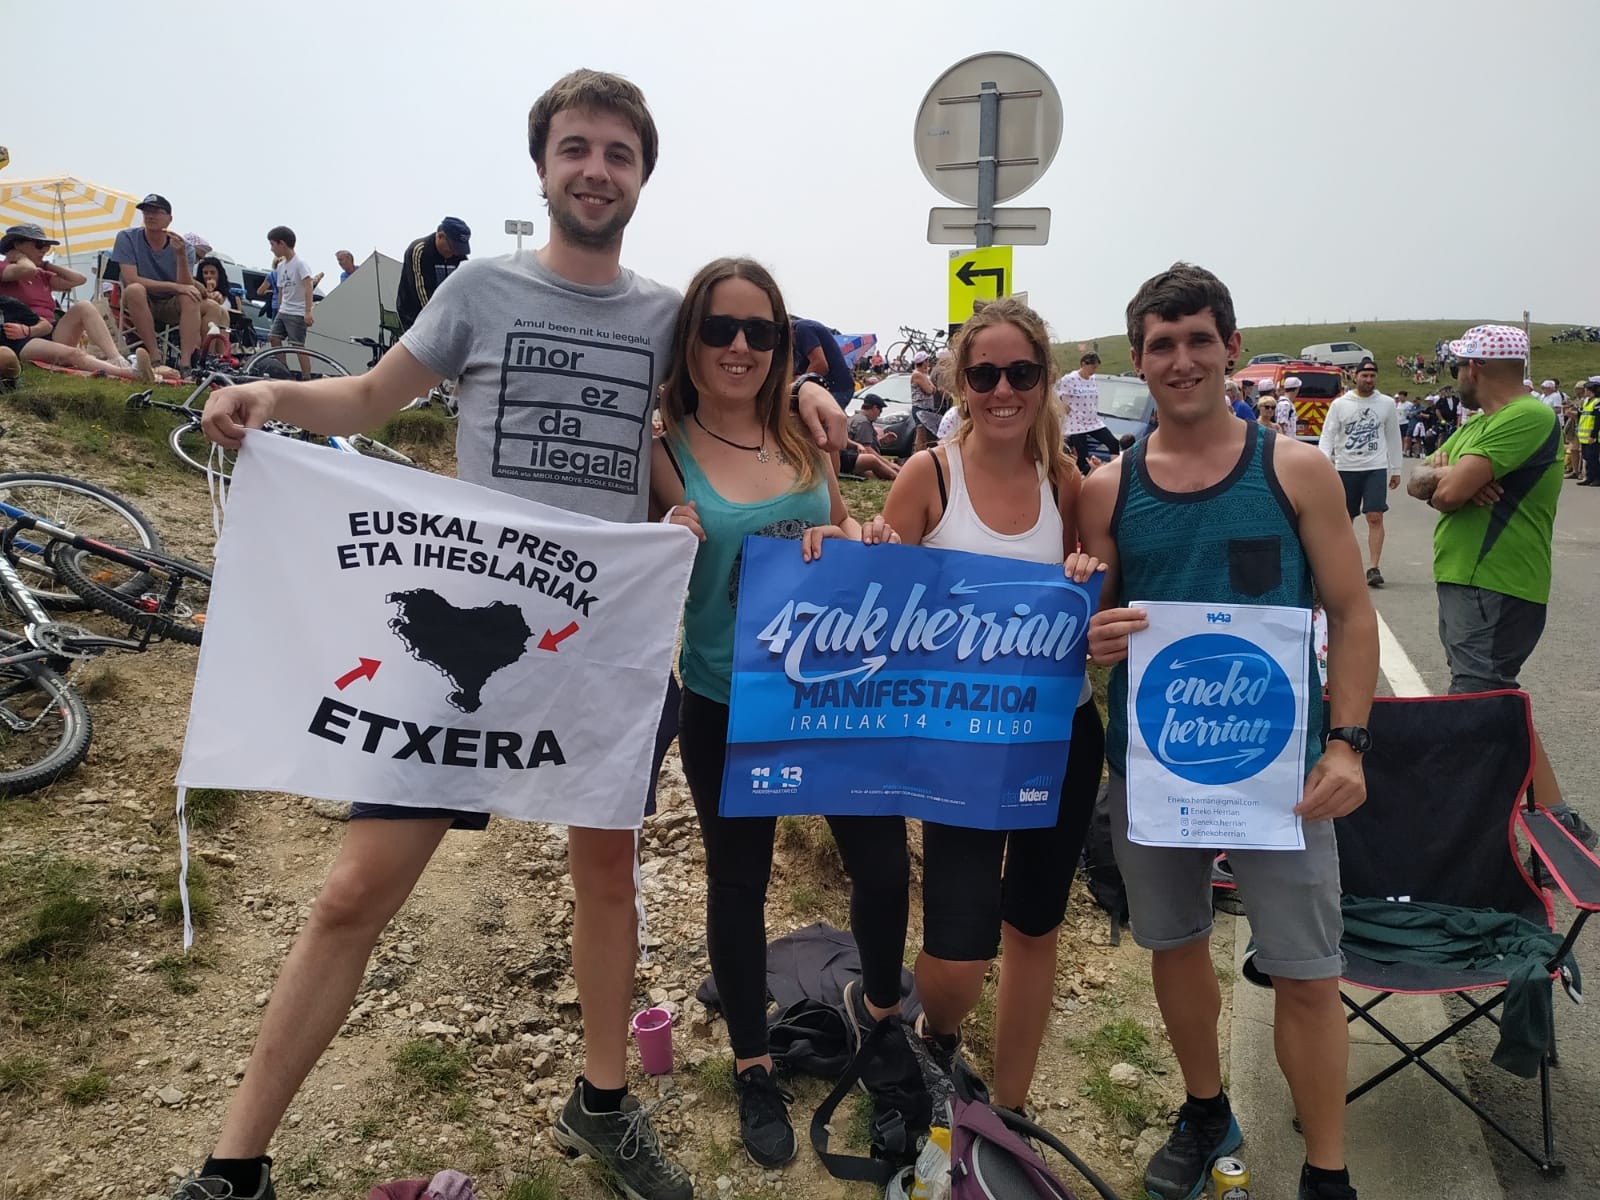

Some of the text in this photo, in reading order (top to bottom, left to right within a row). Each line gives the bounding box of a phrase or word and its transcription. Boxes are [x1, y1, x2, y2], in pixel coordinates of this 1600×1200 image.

[514, 318, 545, 329] Amul
[548, 321, 576, 334] been
[579, 327, 593, 337] nit
[596, 329, 609, 339] ku
[516, 339, 585, 370] inor
[580, 385, 619, 410] ez
[538, 410, 582, 438] da
[530, 441, 632, 480] ilegala
[349, 511, 598, 583] EUSKAL PRESO
[337, 541, 600, 618] ETA IHESLARIAK
[890, 583, 1080, 662] herrian
[793, 678, 1037, 713] MANIFESTAZIOA
[1165, 660, 1270, 707] eneko
[307, 696, 567, 770] ETXERA
[790, 714, 1032, 735] IRAILAK 14 BILBO
[1158, 707, 1271, 748] herrian
[1019, 788, 1049, 802] bidera
[1191, 808, 1213, 816] Eneko
